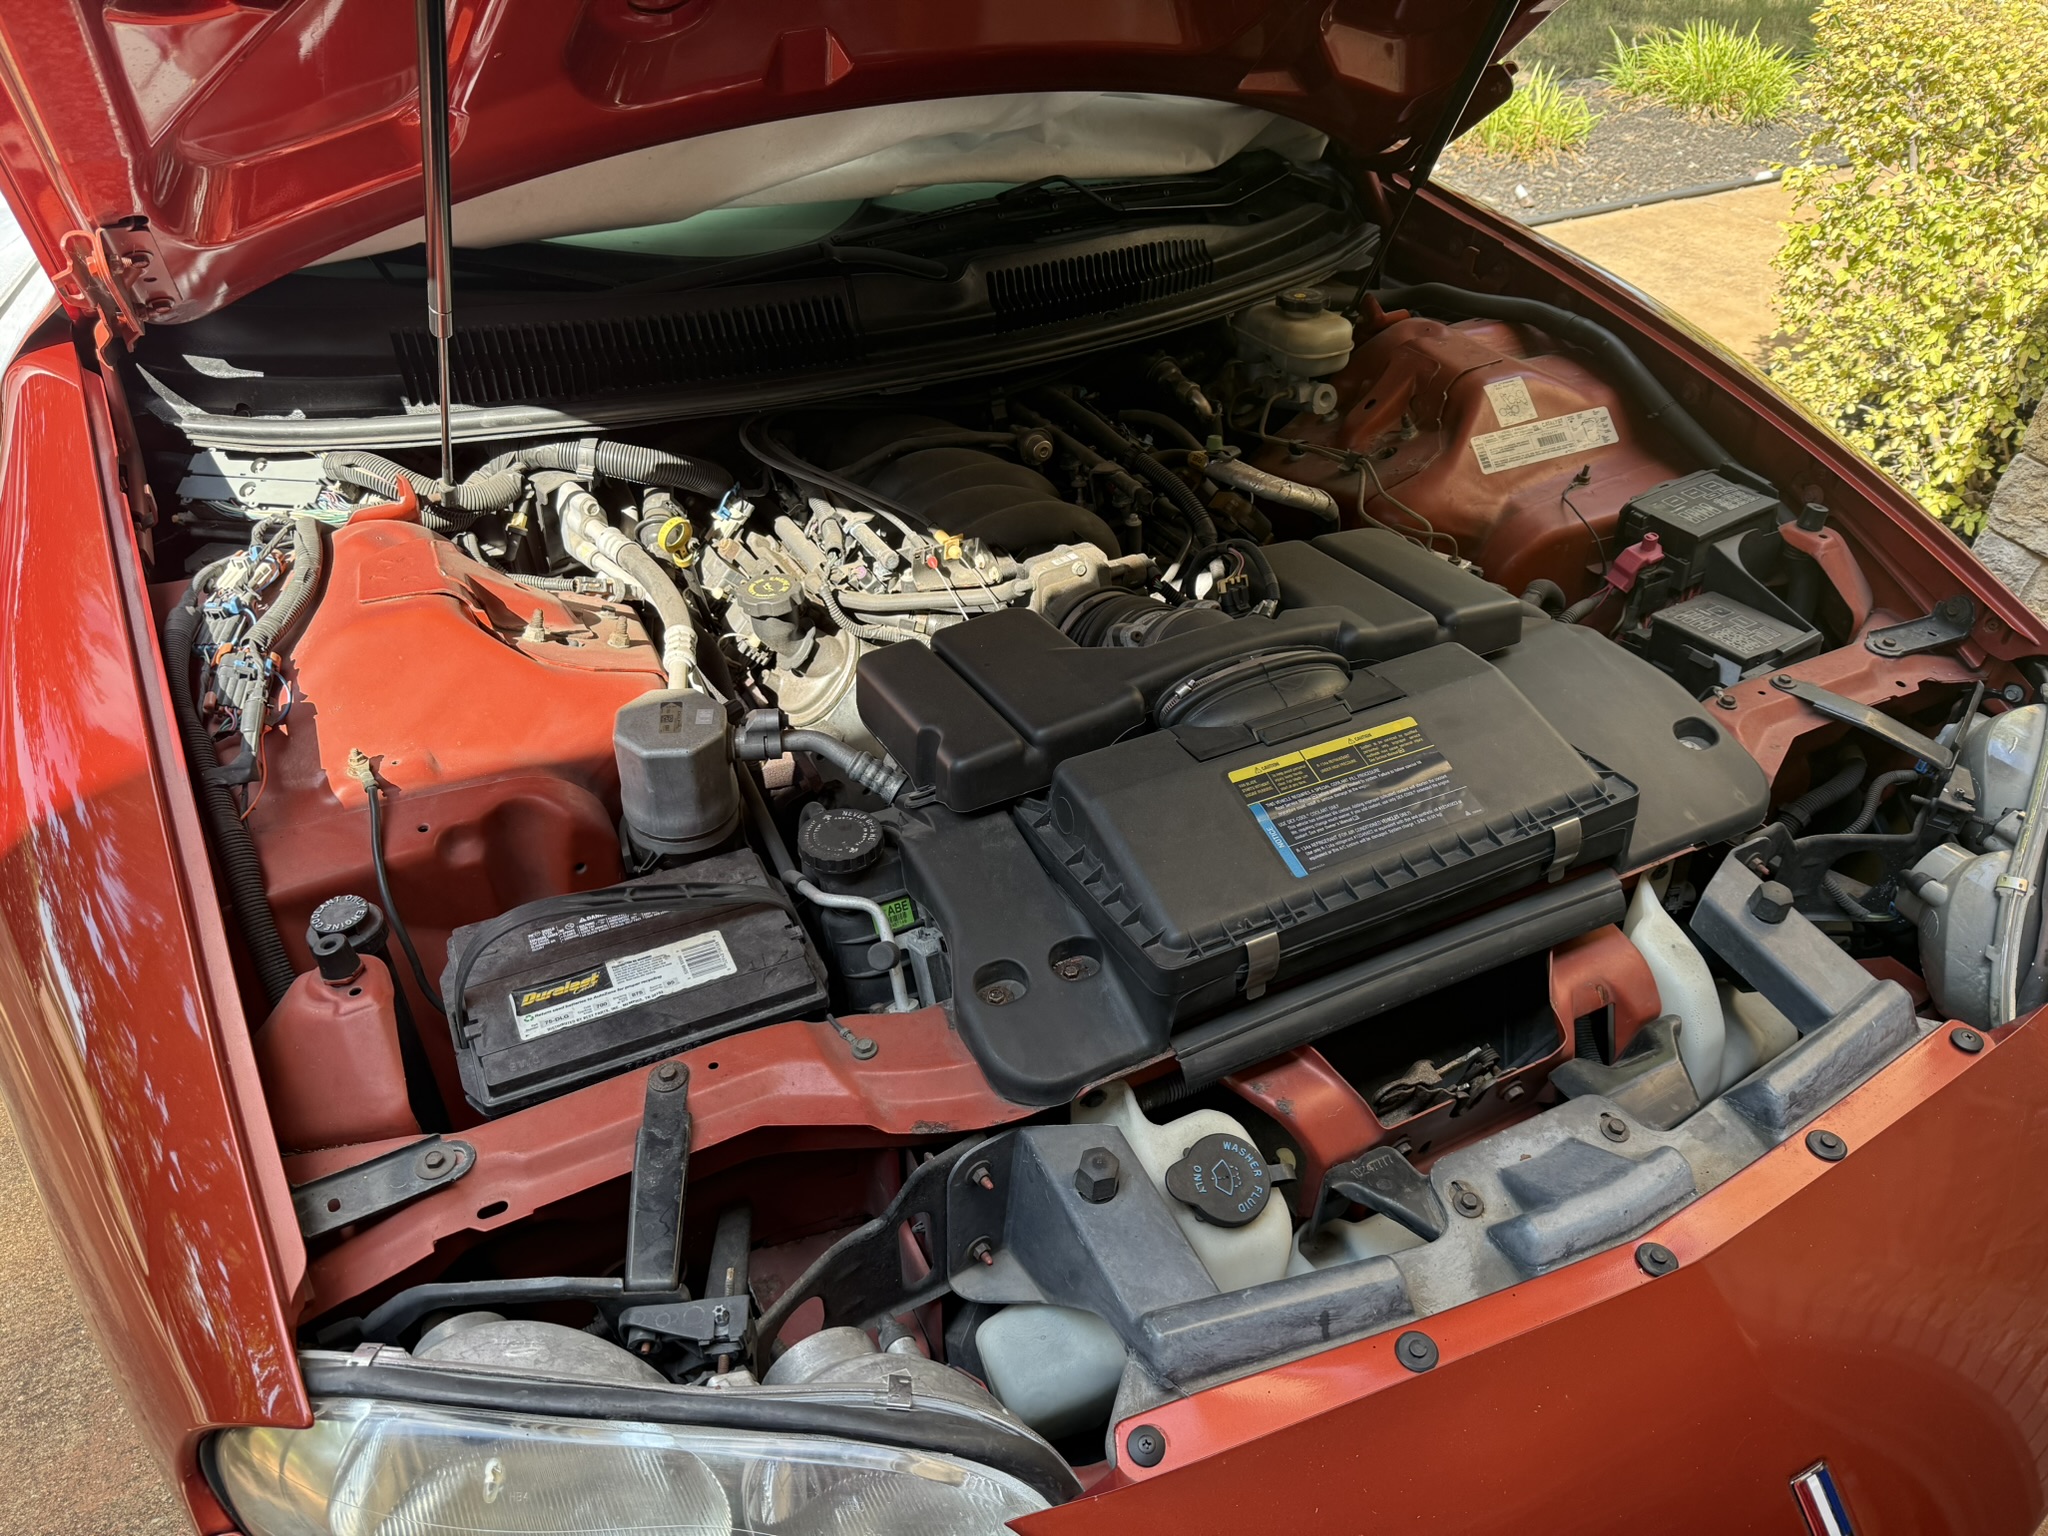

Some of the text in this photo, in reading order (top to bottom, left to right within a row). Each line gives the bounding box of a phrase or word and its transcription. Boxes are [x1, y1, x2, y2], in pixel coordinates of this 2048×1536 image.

[1353, 732, 1372, 741] CAUTION
[1260, 761, 1280, 771] CAUTION
[842, 810, 868, 820] NEVER
[1265, 825, 1286, 849] NOTICE
[311, 894, 368, 931] ENGINE COOLANT ONLY
[887, 900, 909, 917] ABE
[521, 973, 599, 1008] Duralast
[1193, 1141, 1263, 1213] WASHER FLUID ONLY
